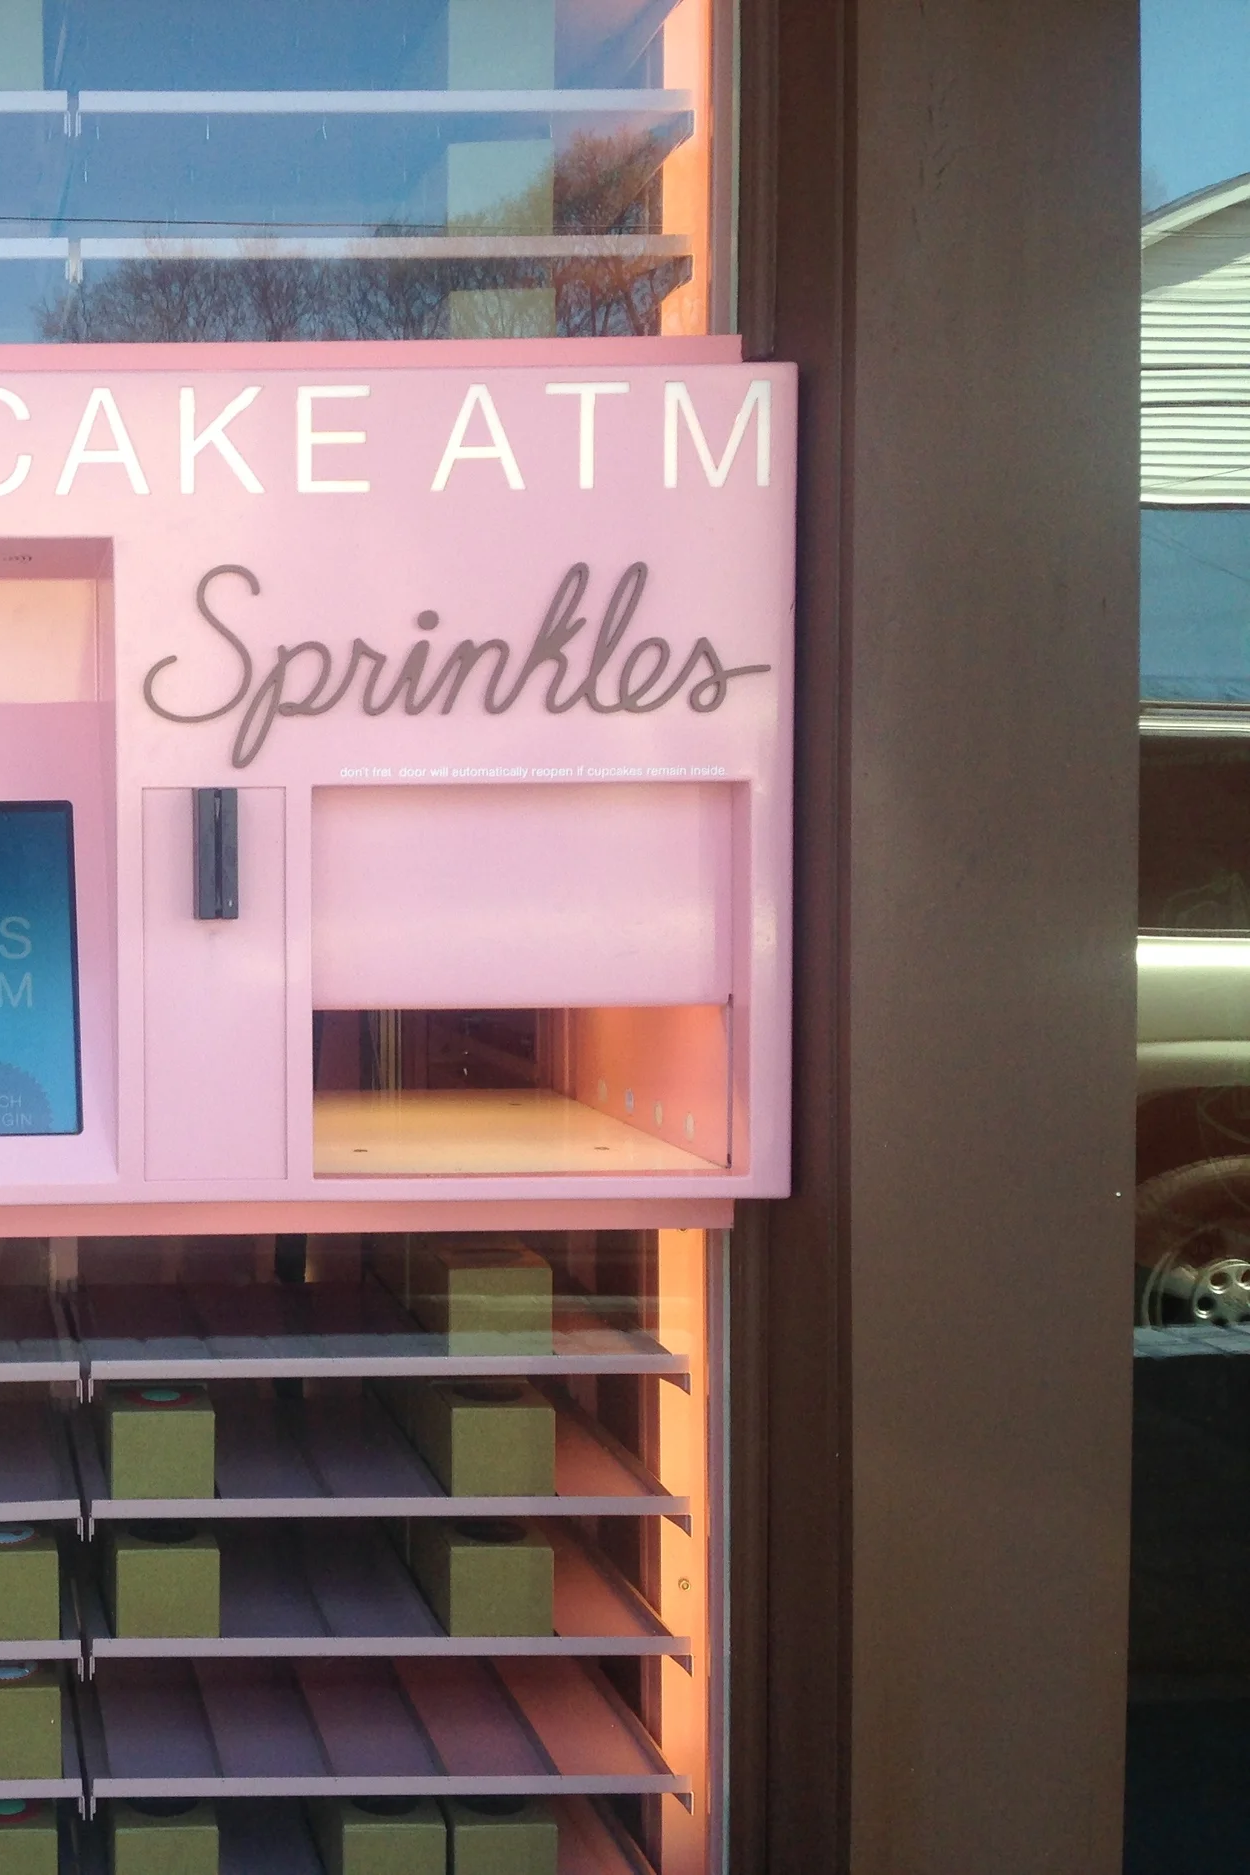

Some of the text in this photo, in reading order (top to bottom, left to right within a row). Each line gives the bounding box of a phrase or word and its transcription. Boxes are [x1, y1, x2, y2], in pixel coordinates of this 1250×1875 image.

[429, 379, 772, 491] ATM
[142, 561, 772, 769] Sprinkles
[339, 766, 369, 777] don't
[399, 766, 426, 777] door
[430, 766, 449, 777] will
[452, 766, 528, 779] automatically
[531, 767, 573, 778] reopen
[577, 765, 584, 776] if
[587, 765, 643, 777] cupcakes
[646, 765, 687, 776] remain
